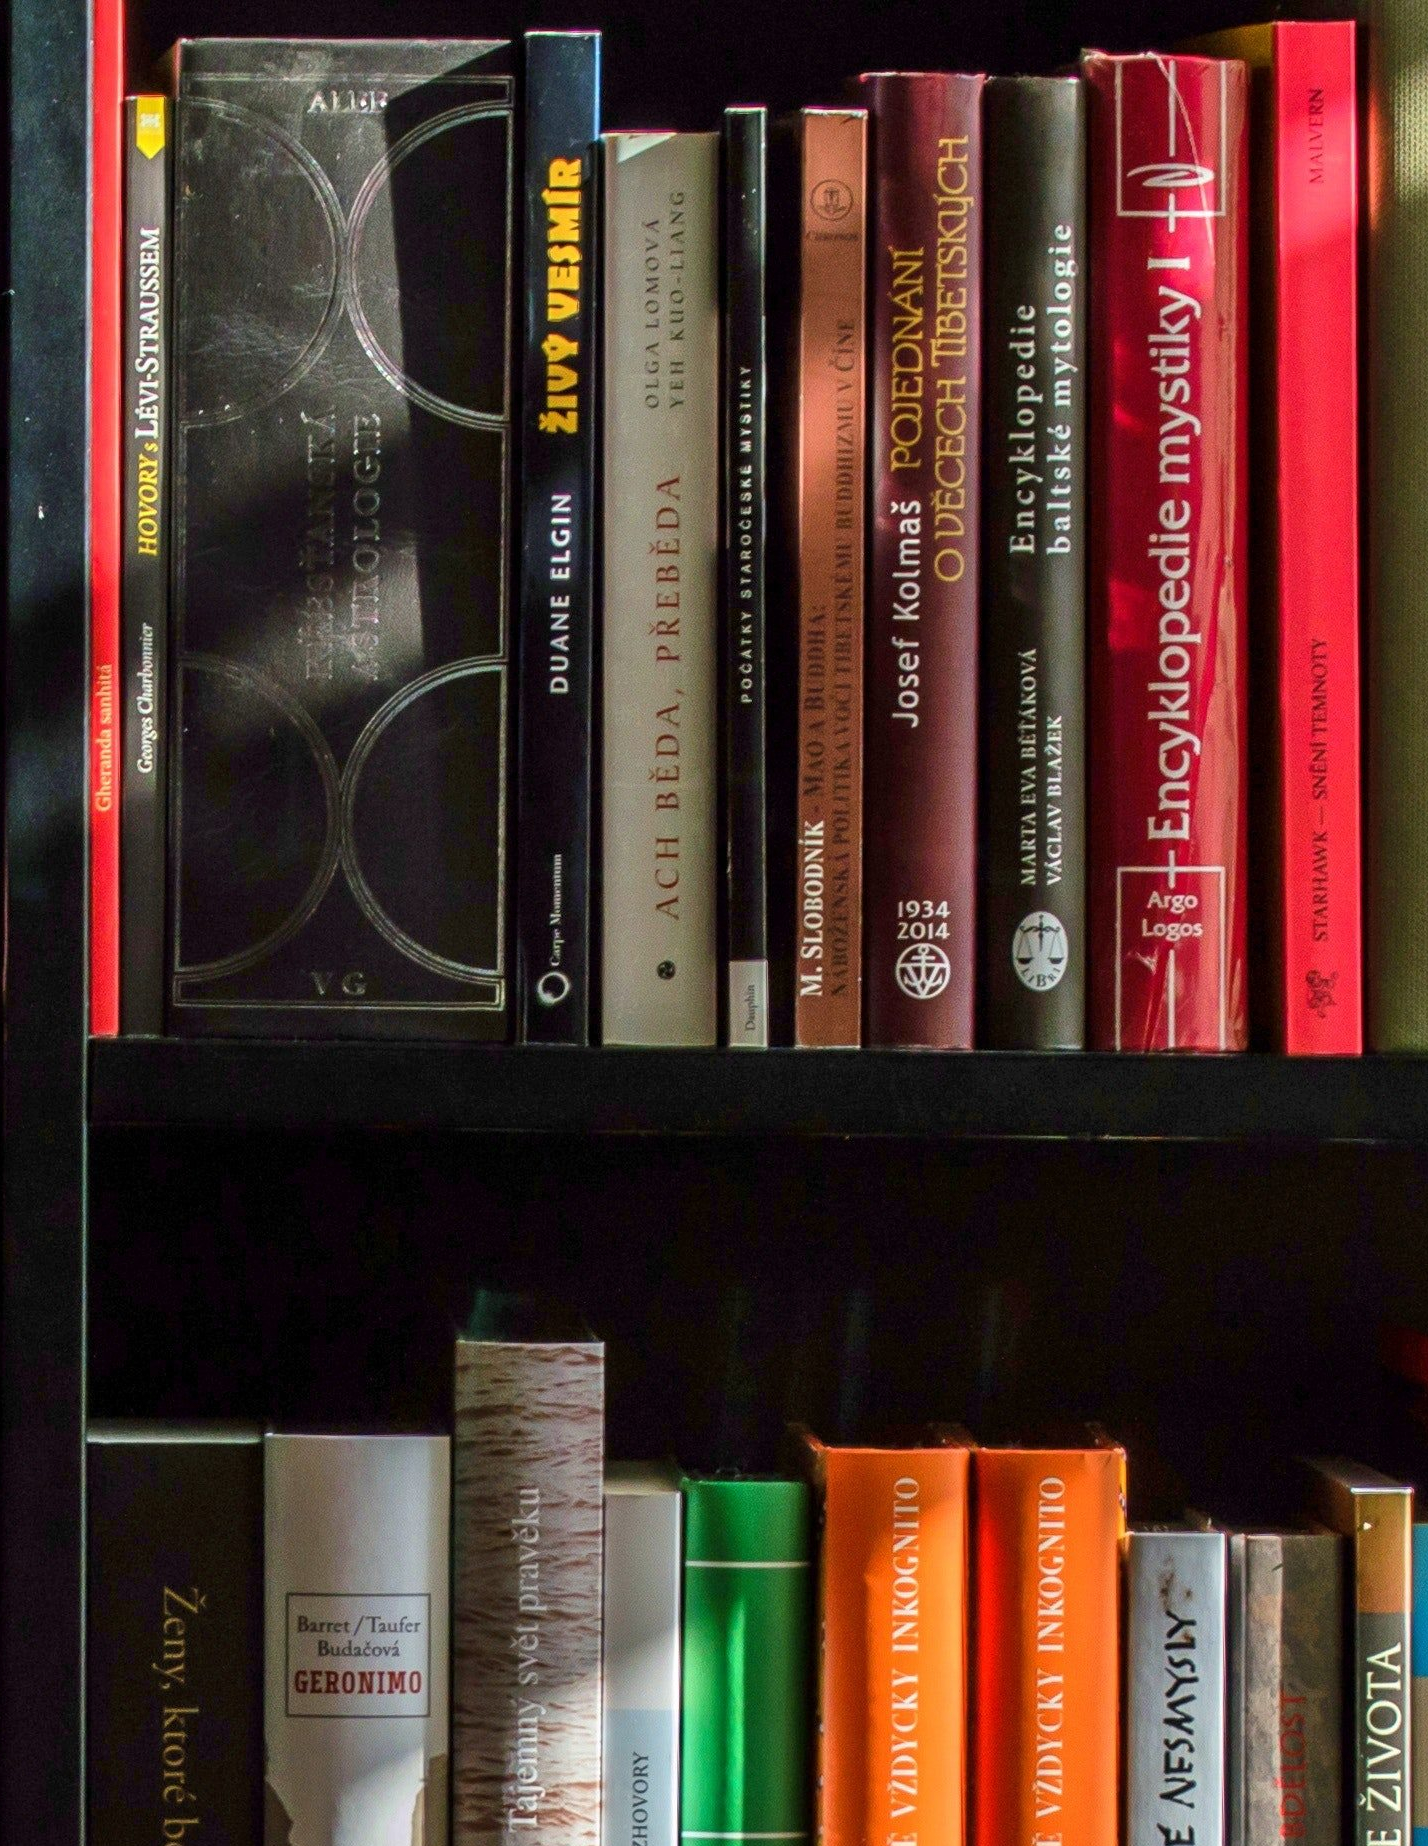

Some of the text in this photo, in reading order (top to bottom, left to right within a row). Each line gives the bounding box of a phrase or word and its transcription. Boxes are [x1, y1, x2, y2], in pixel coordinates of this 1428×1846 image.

[644, 341, 660, 410] OLGA
[669, 361, 685, 410] YEH
[929, 134, 974, 540] VĚCECH TIBETSKÝCH
[1046, 225, 1079, 555] baltské mytologie
[537, 158, 582, 694] DUANE ELGIN ŽIVÝ VESMÍR
[888, 244, 924, 728] Josef Kolmaš POJEDNÁNÍ
[1009, 304, 1044, 554] Encyklopedie
[136, 453, 160, 774] Georges HOVORY
[1147, 284, 1202, 840] Encyklopedie mystiky
[95, 730, 113, 811] Gheranda
[1021, 766, 1038, 886] MARTA EVA
[654, 835, 681, 920] ACH
[897, 899, 951, 919] 1934
[1042, 804, 1063, 886] VÁCLAV
[1147, 891, 1199, 916] Argo
[897, 921, 951, 941] 2014
[1142, 917, 1204, 943] Logos
[152, 1586, 207, 1802] Ženy, ktoré
[294, 1669, 423, 1692] GERONIMO
[296, 1615, 350, 1635] Barret
[317, 1638, 402, 1658] Budačová
[505, 1487, 547, 1834] Tajemný svět pravěku
[886, 1476, 921, 1818] VŽDYCKY INKOGNITO
[1032, 1476, 1065, 1818] VŽDYCKY INKOGNITO
[1158, 1610, 1199, 1809] NESMYSLY
[1357, 1642, 1402, 1812] ŽIVOTA
